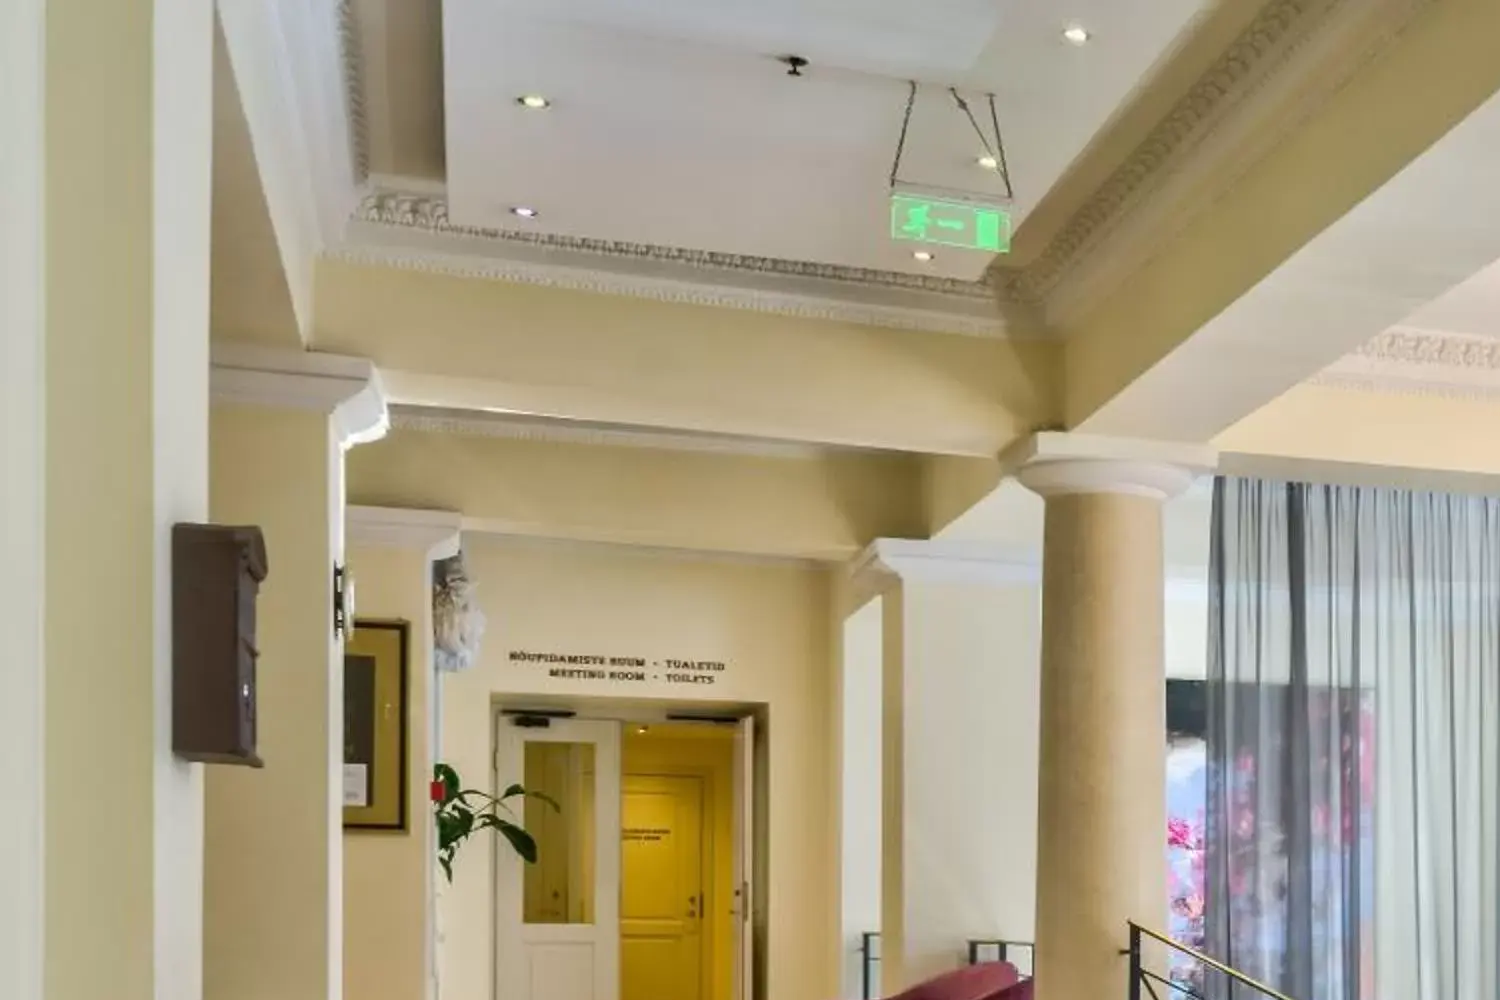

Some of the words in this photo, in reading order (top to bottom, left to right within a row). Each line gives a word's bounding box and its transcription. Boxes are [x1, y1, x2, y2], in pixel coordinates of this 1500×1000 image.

[609, 657, 646, 667] RUUM
[665, 659, 725, 671] TUALETID
[549, 668, 606, 680] MEETING
[608, 671, 645, 681] ROOM
[665, 673, 715, 684] TOILETS
